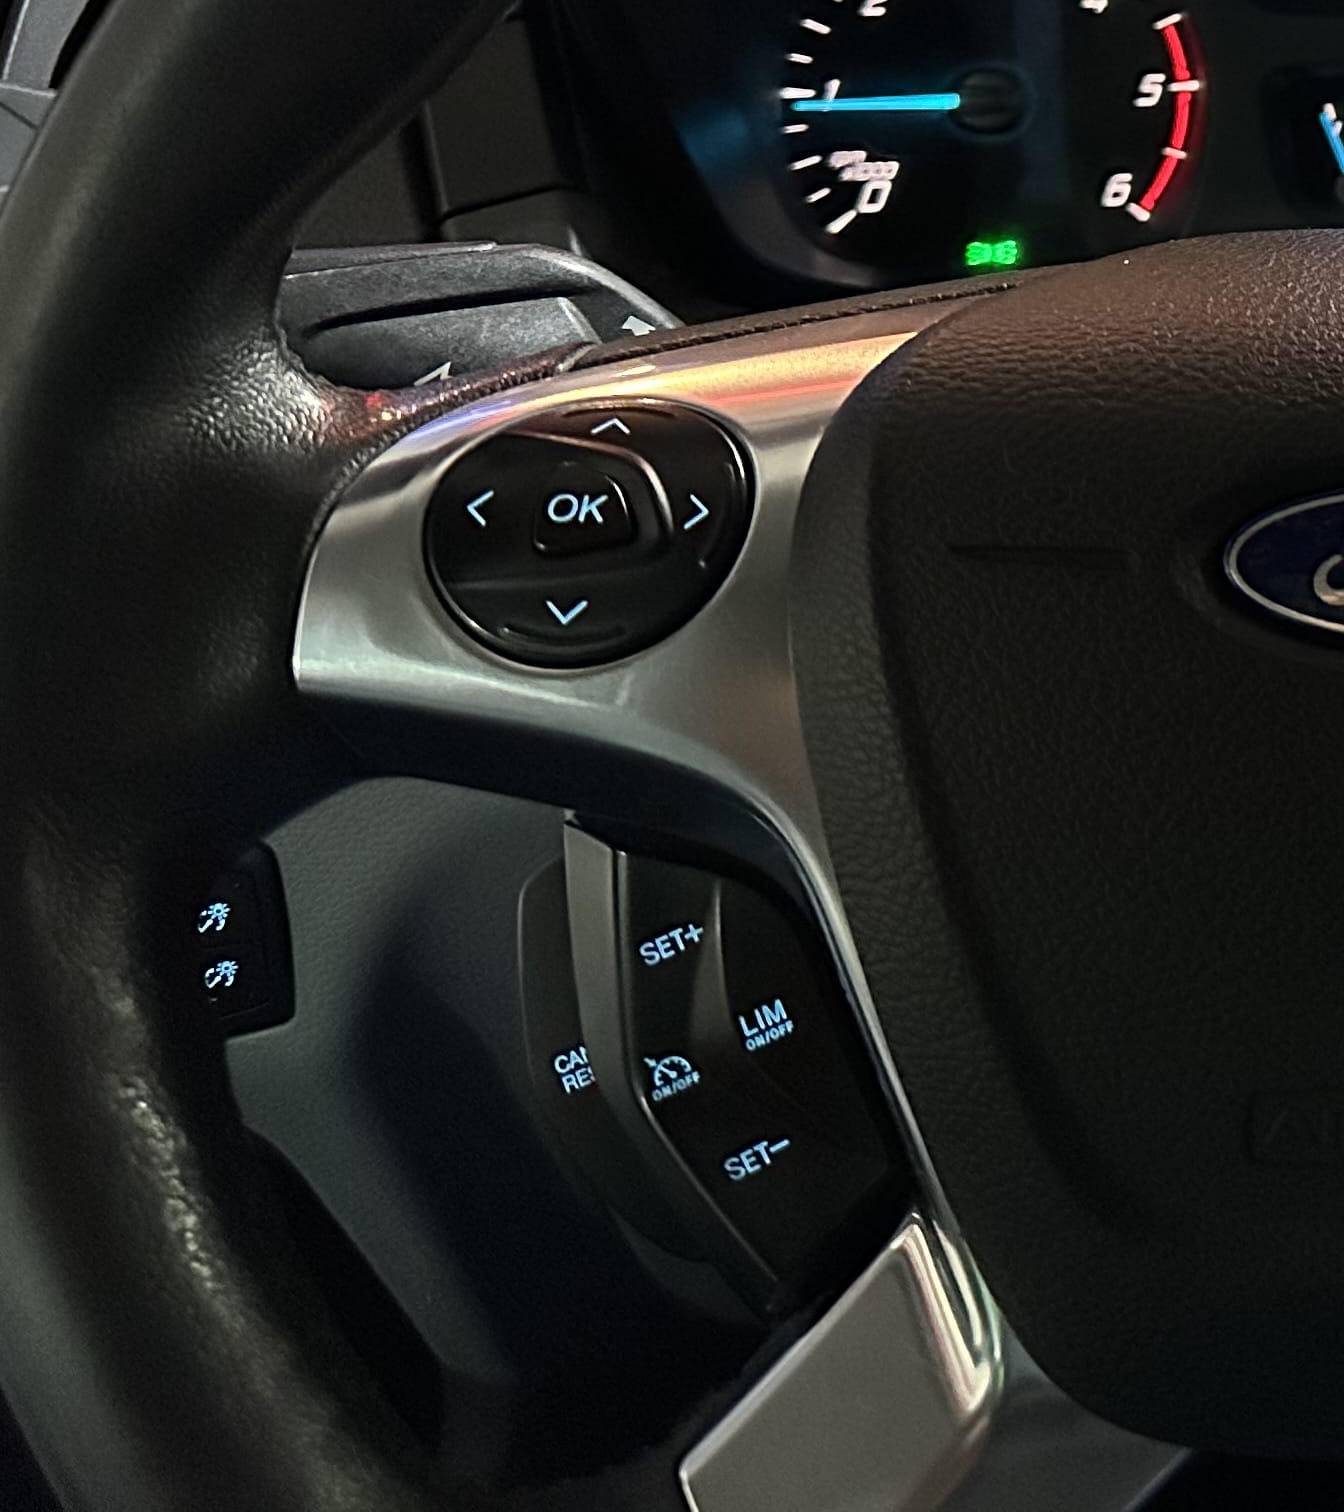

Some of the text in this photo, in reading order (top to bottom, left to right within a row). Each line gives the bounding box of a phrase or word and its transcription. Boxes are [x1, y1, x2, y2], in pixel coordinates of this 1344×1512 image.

[1133, 72, 1167, 107] 5
[856, 179, 893, 214] 0
[1100, 172, 1134, 208] 6
[547, 493, 609, 524] OK
[639, 924, 704, 966] SET+
[738, 999, 788, 1038] LIM
[745, 1019, 795, 1051] ON/OFF
[651, 1070, 701, 1102] ON/OFF
